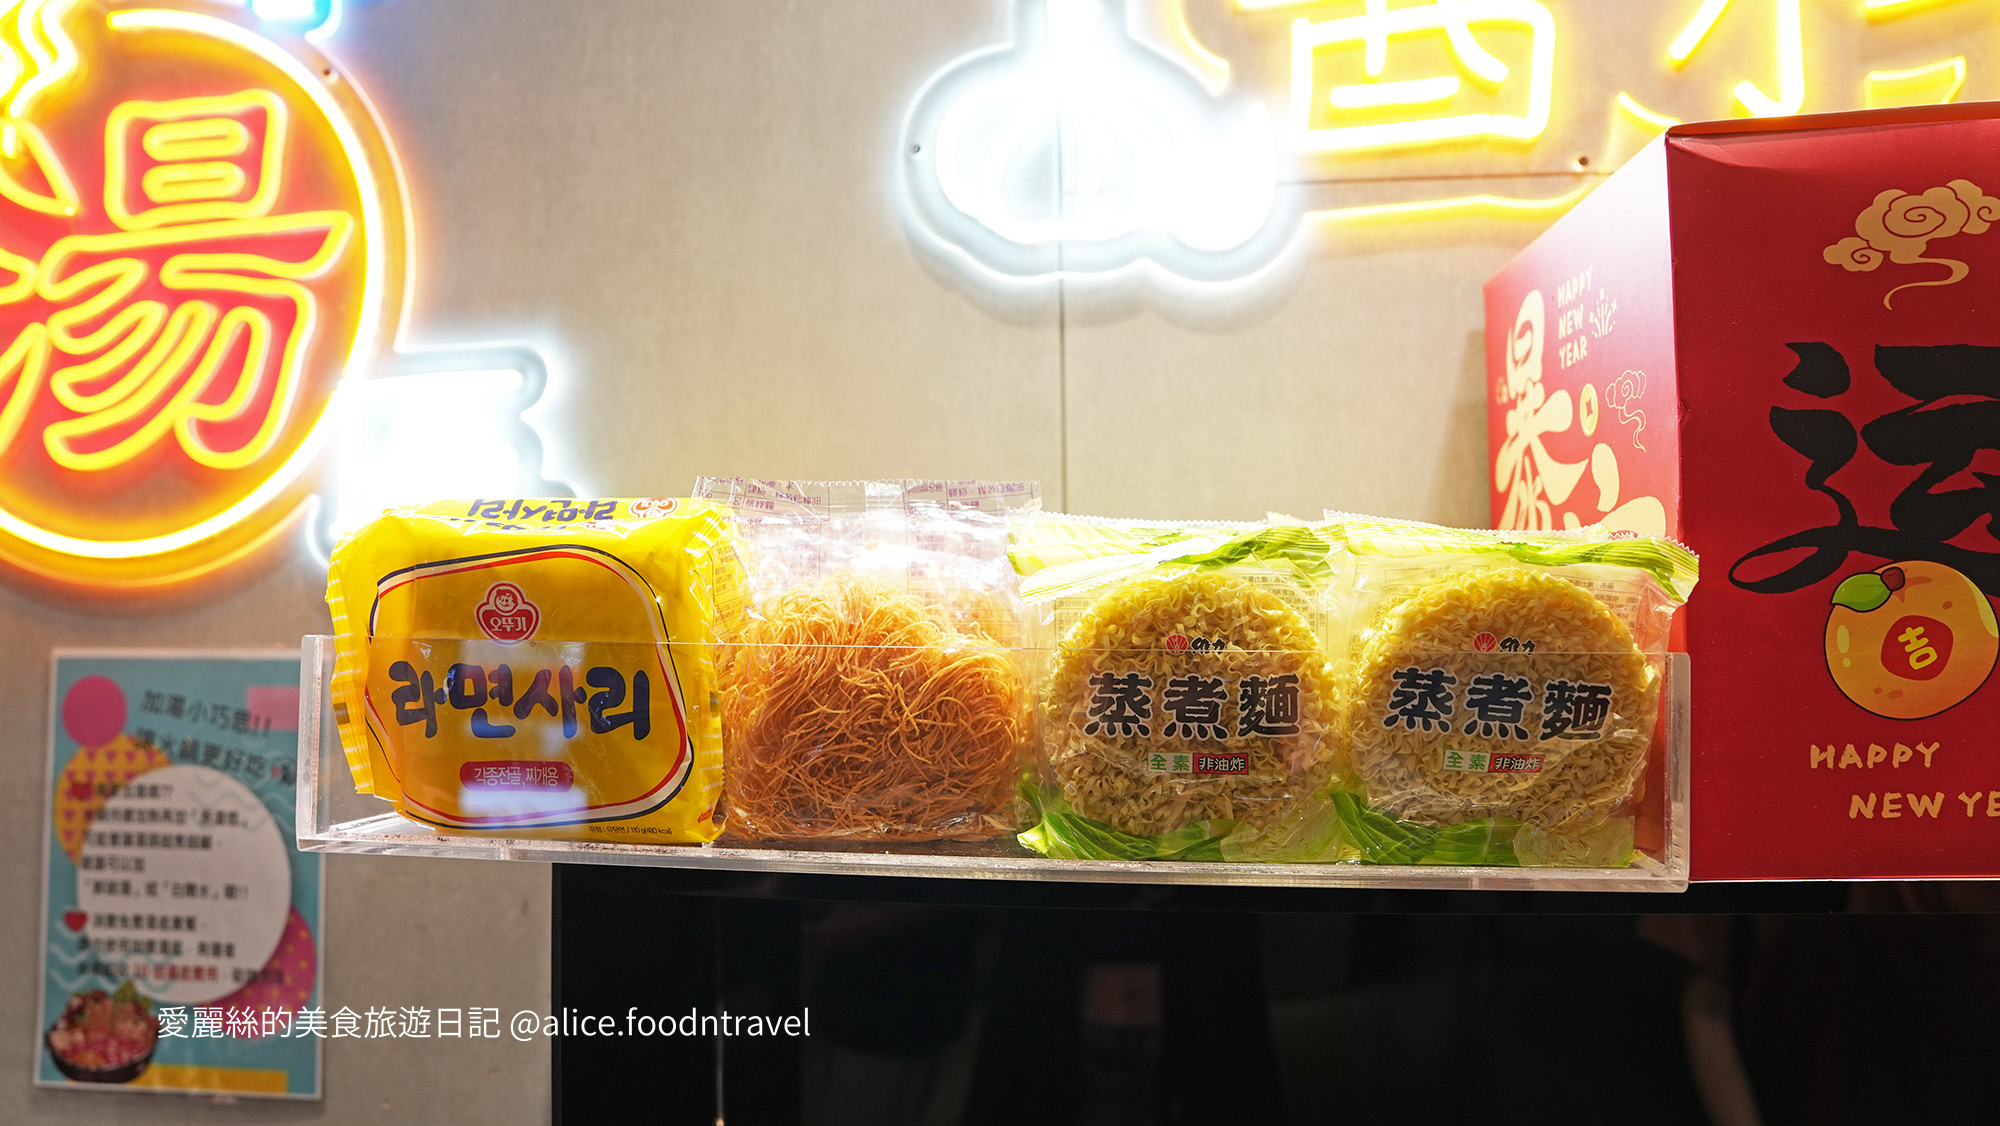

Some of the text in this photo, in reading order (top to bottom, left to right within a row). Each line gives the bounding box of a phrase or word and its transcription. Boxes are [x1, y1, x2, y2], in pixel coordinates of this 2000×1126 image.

[0, 88, 354, 472] 湯
[1557, 265, 1593, 309] HAPPY
[1558, 304, 1584, 340] NEW
[1558, 336, 1588, 370] YEAR
[488, 616, 528, 633] 오뚜기
[1898, 625, 1937, 670] 吉
[388, 660, 651, 741] 라면사리
[1084, 672, 1301, 739] 蒸煮麵
[1383, 667, 1612, 741] 蒸煮麵
[1150, 754, 1246, 772] 全素 非油炸
[1445, 751, 1541, 771] 全素 非油炸
[1809, 741, 1941, 770] HAPPY
[1848, 792, 1945, 821] NEW
